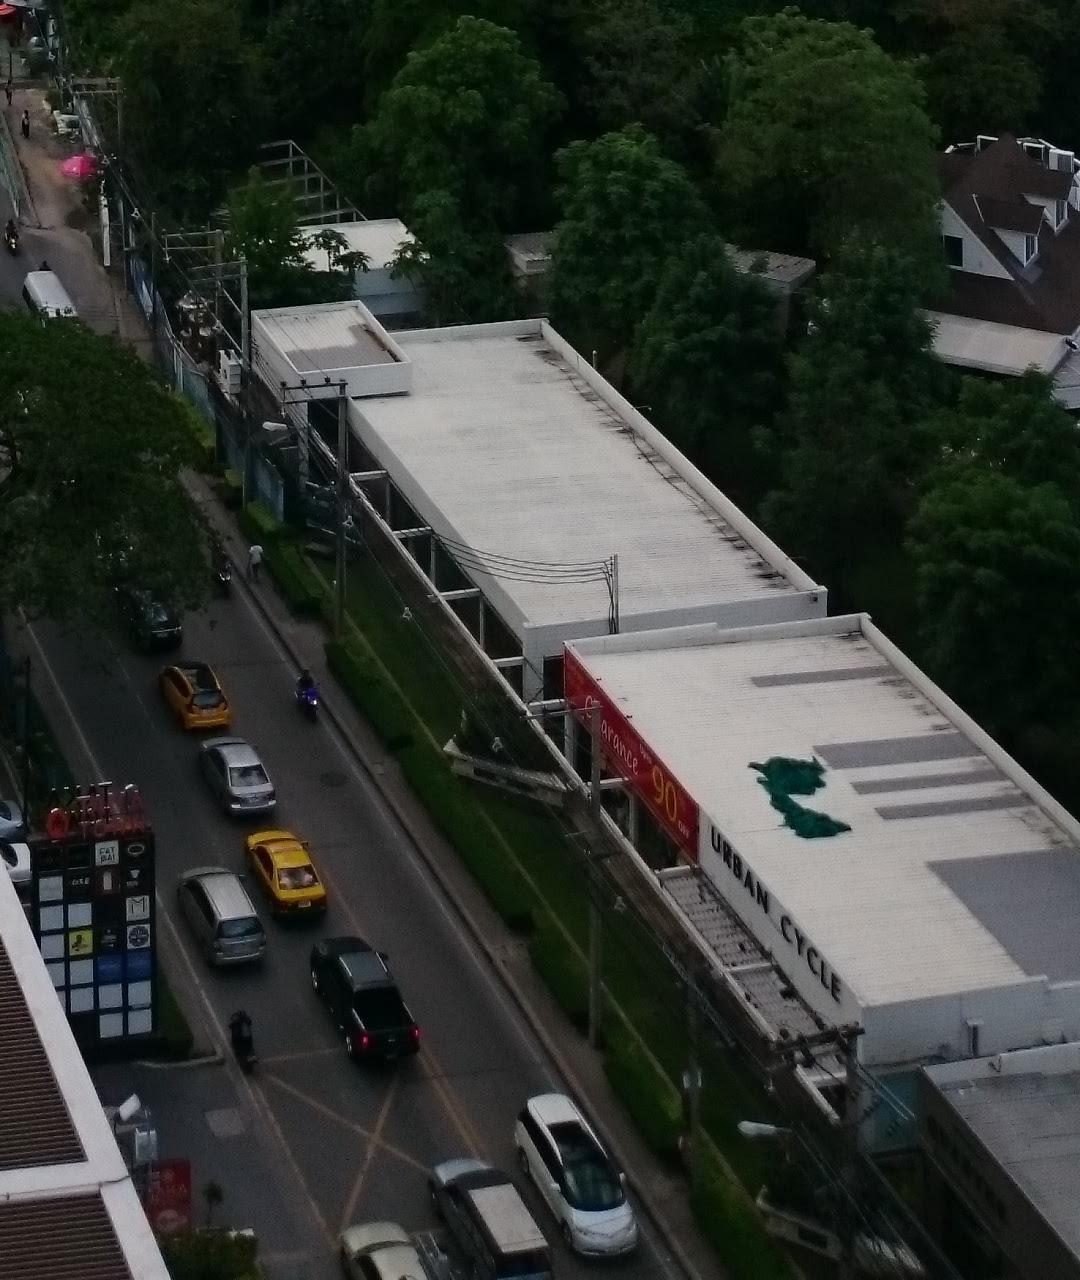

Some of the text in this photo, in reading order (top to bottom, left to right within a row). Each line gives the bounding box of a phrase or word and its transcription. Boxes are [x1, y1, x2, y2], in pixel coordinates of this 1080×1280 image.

[584, 694, 639, 776] Carance
[711, 826, 842, 1005] URBAN CYCLE
